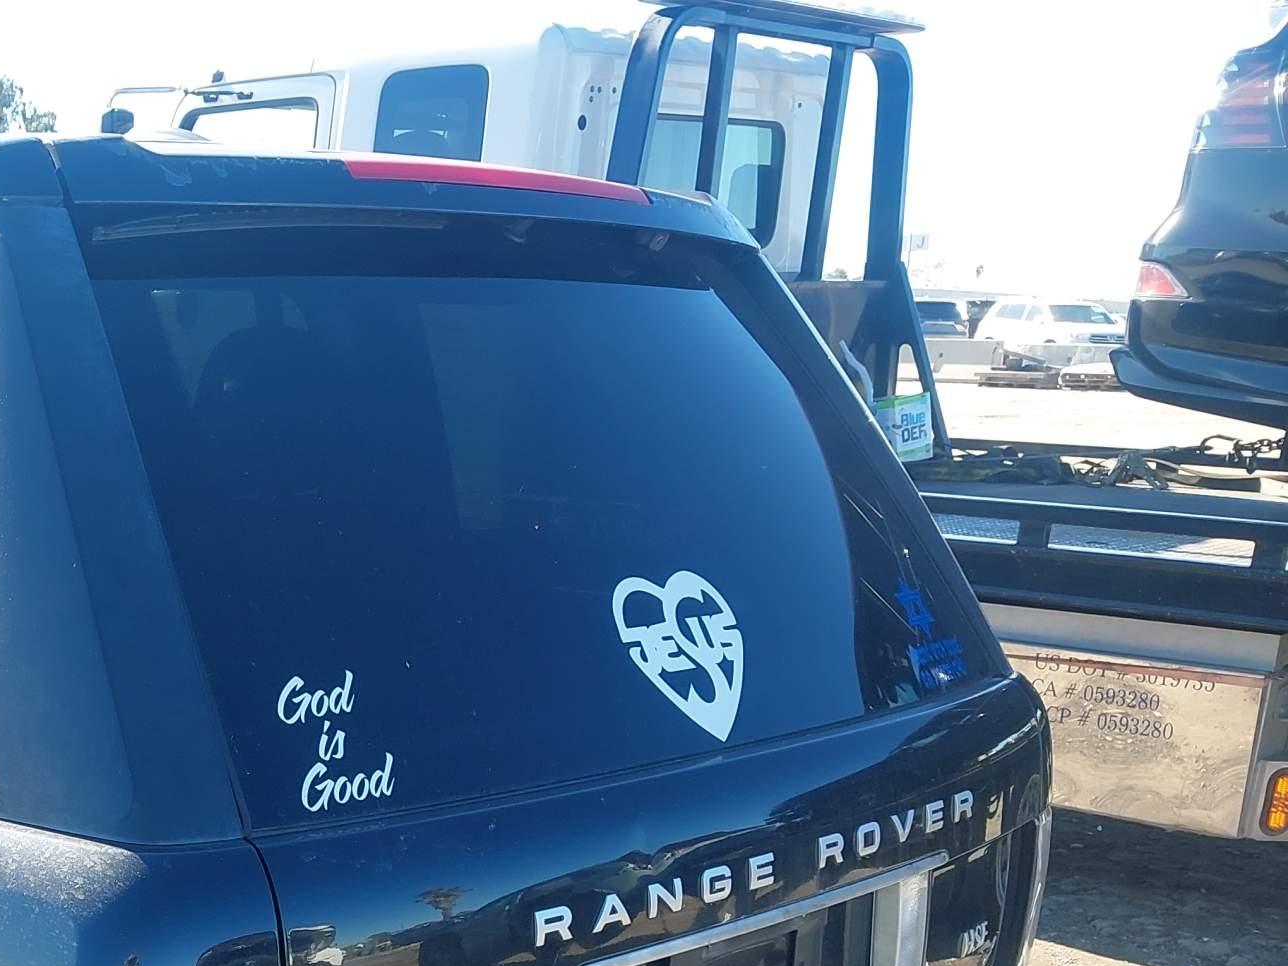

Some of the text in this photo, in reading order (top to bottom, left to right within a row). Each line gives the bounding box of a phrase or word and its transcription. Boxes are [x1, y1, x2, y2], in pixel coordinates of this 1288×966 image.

[900, 411, 926, 427] Blue
[1034, 652, 1062, 672] US
[277, 669, 355, 725] God
[1031, 678, 1161, 711] CA # 0593280
[318, 720, 346, 761] is
[1077, 710, 1092, 727] #
[1096, 712, 1175, 740] 0593280
[301, 751, 396, 812] Good
[534, 789, 975, 948] RANGE ROVER
